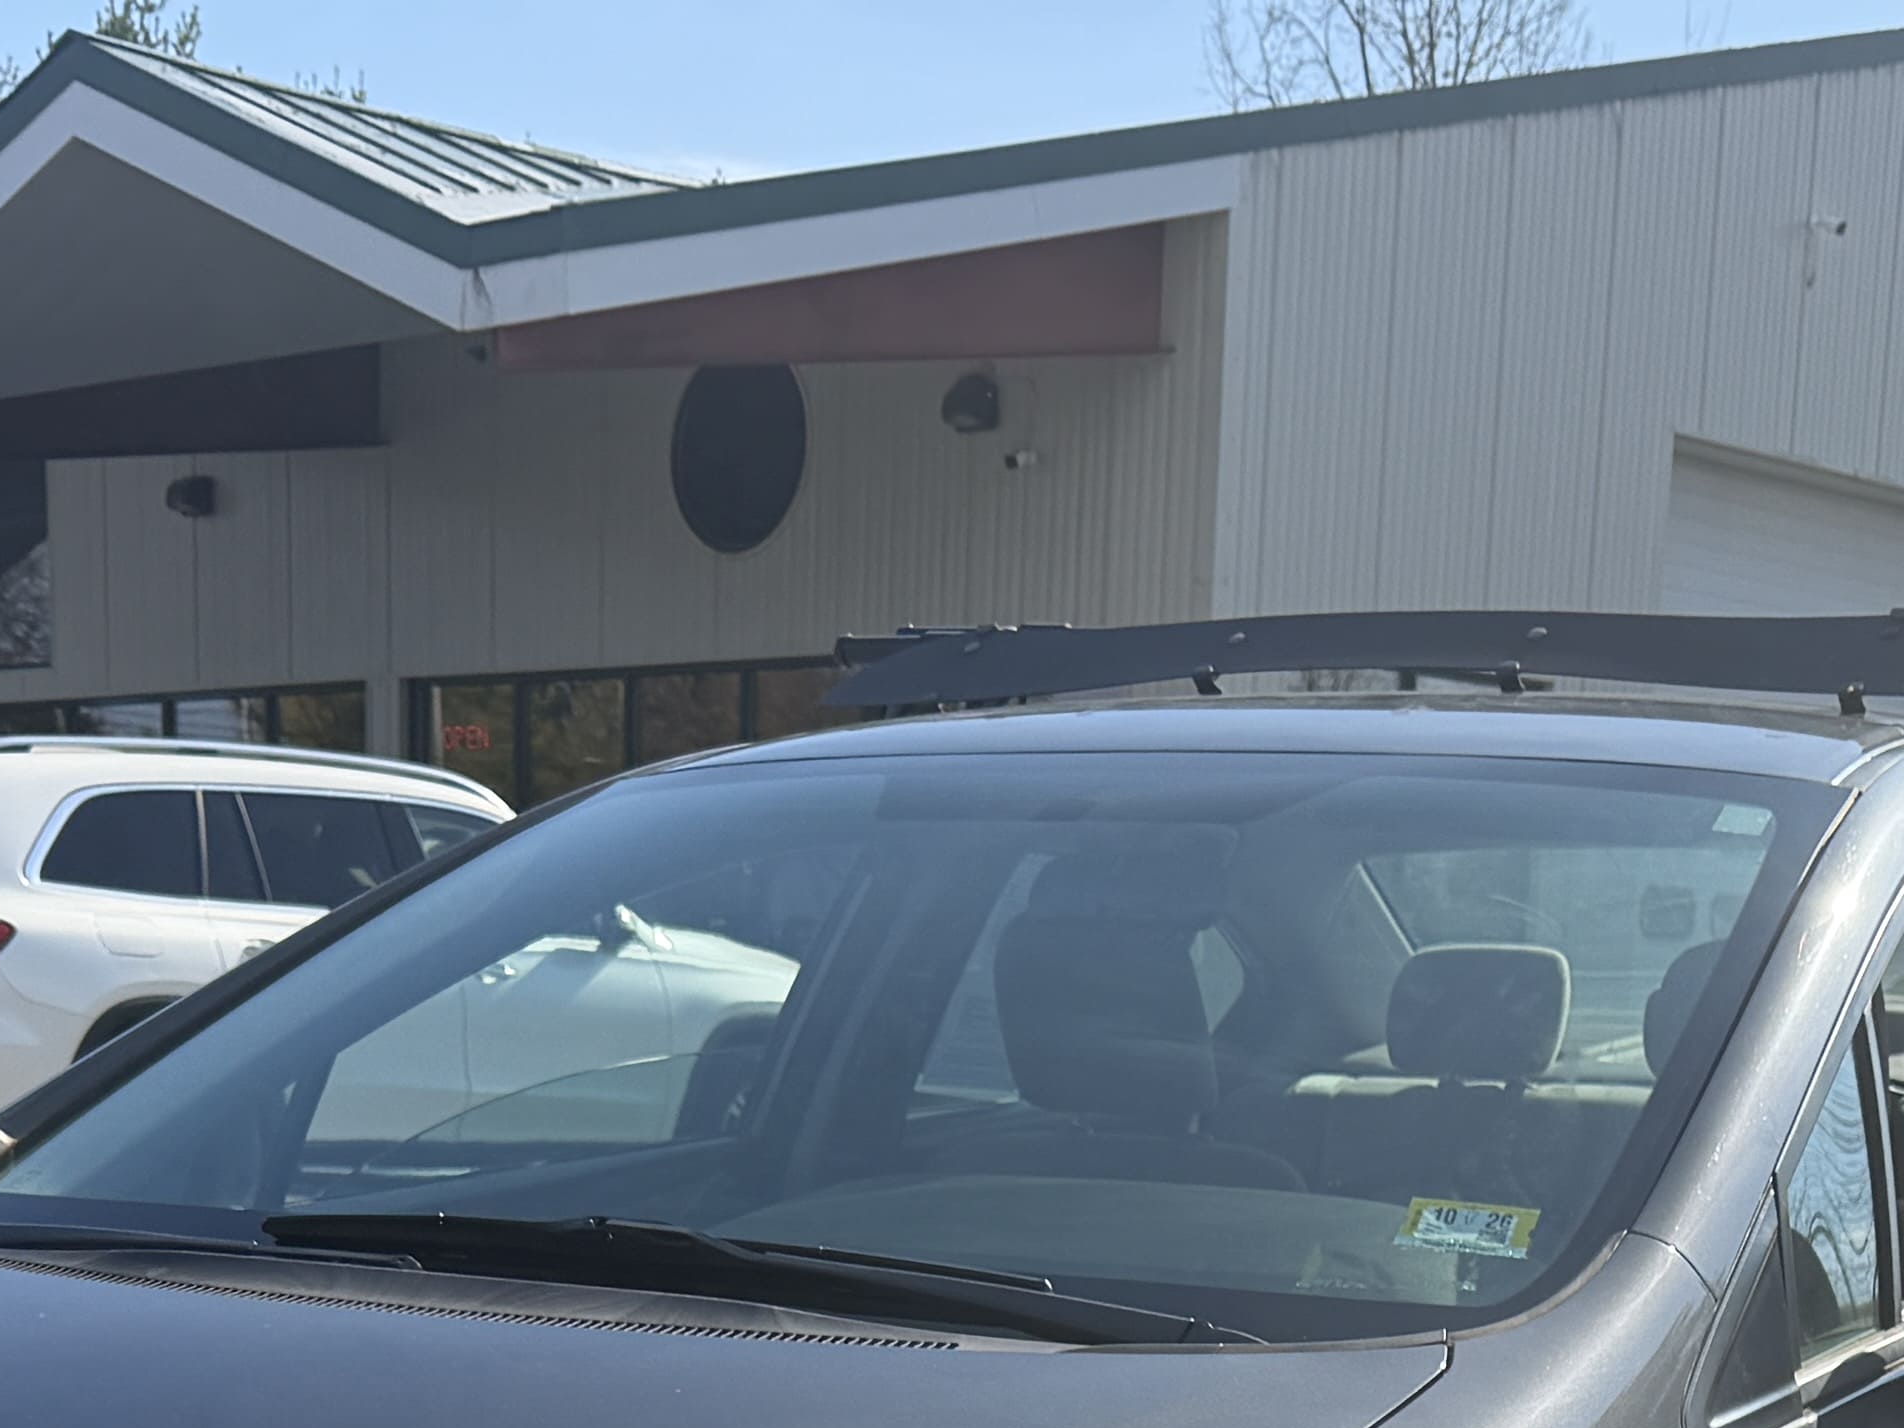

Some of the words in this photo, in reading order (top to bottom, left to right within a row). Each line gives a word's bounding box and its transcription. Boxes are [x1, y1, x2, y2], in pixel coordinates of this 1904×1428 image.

[443, 725, 490, 752] OPEN
[1434, 1207, 1458, 1226] 10
[1485, 1212, 1514, 1229] 26
